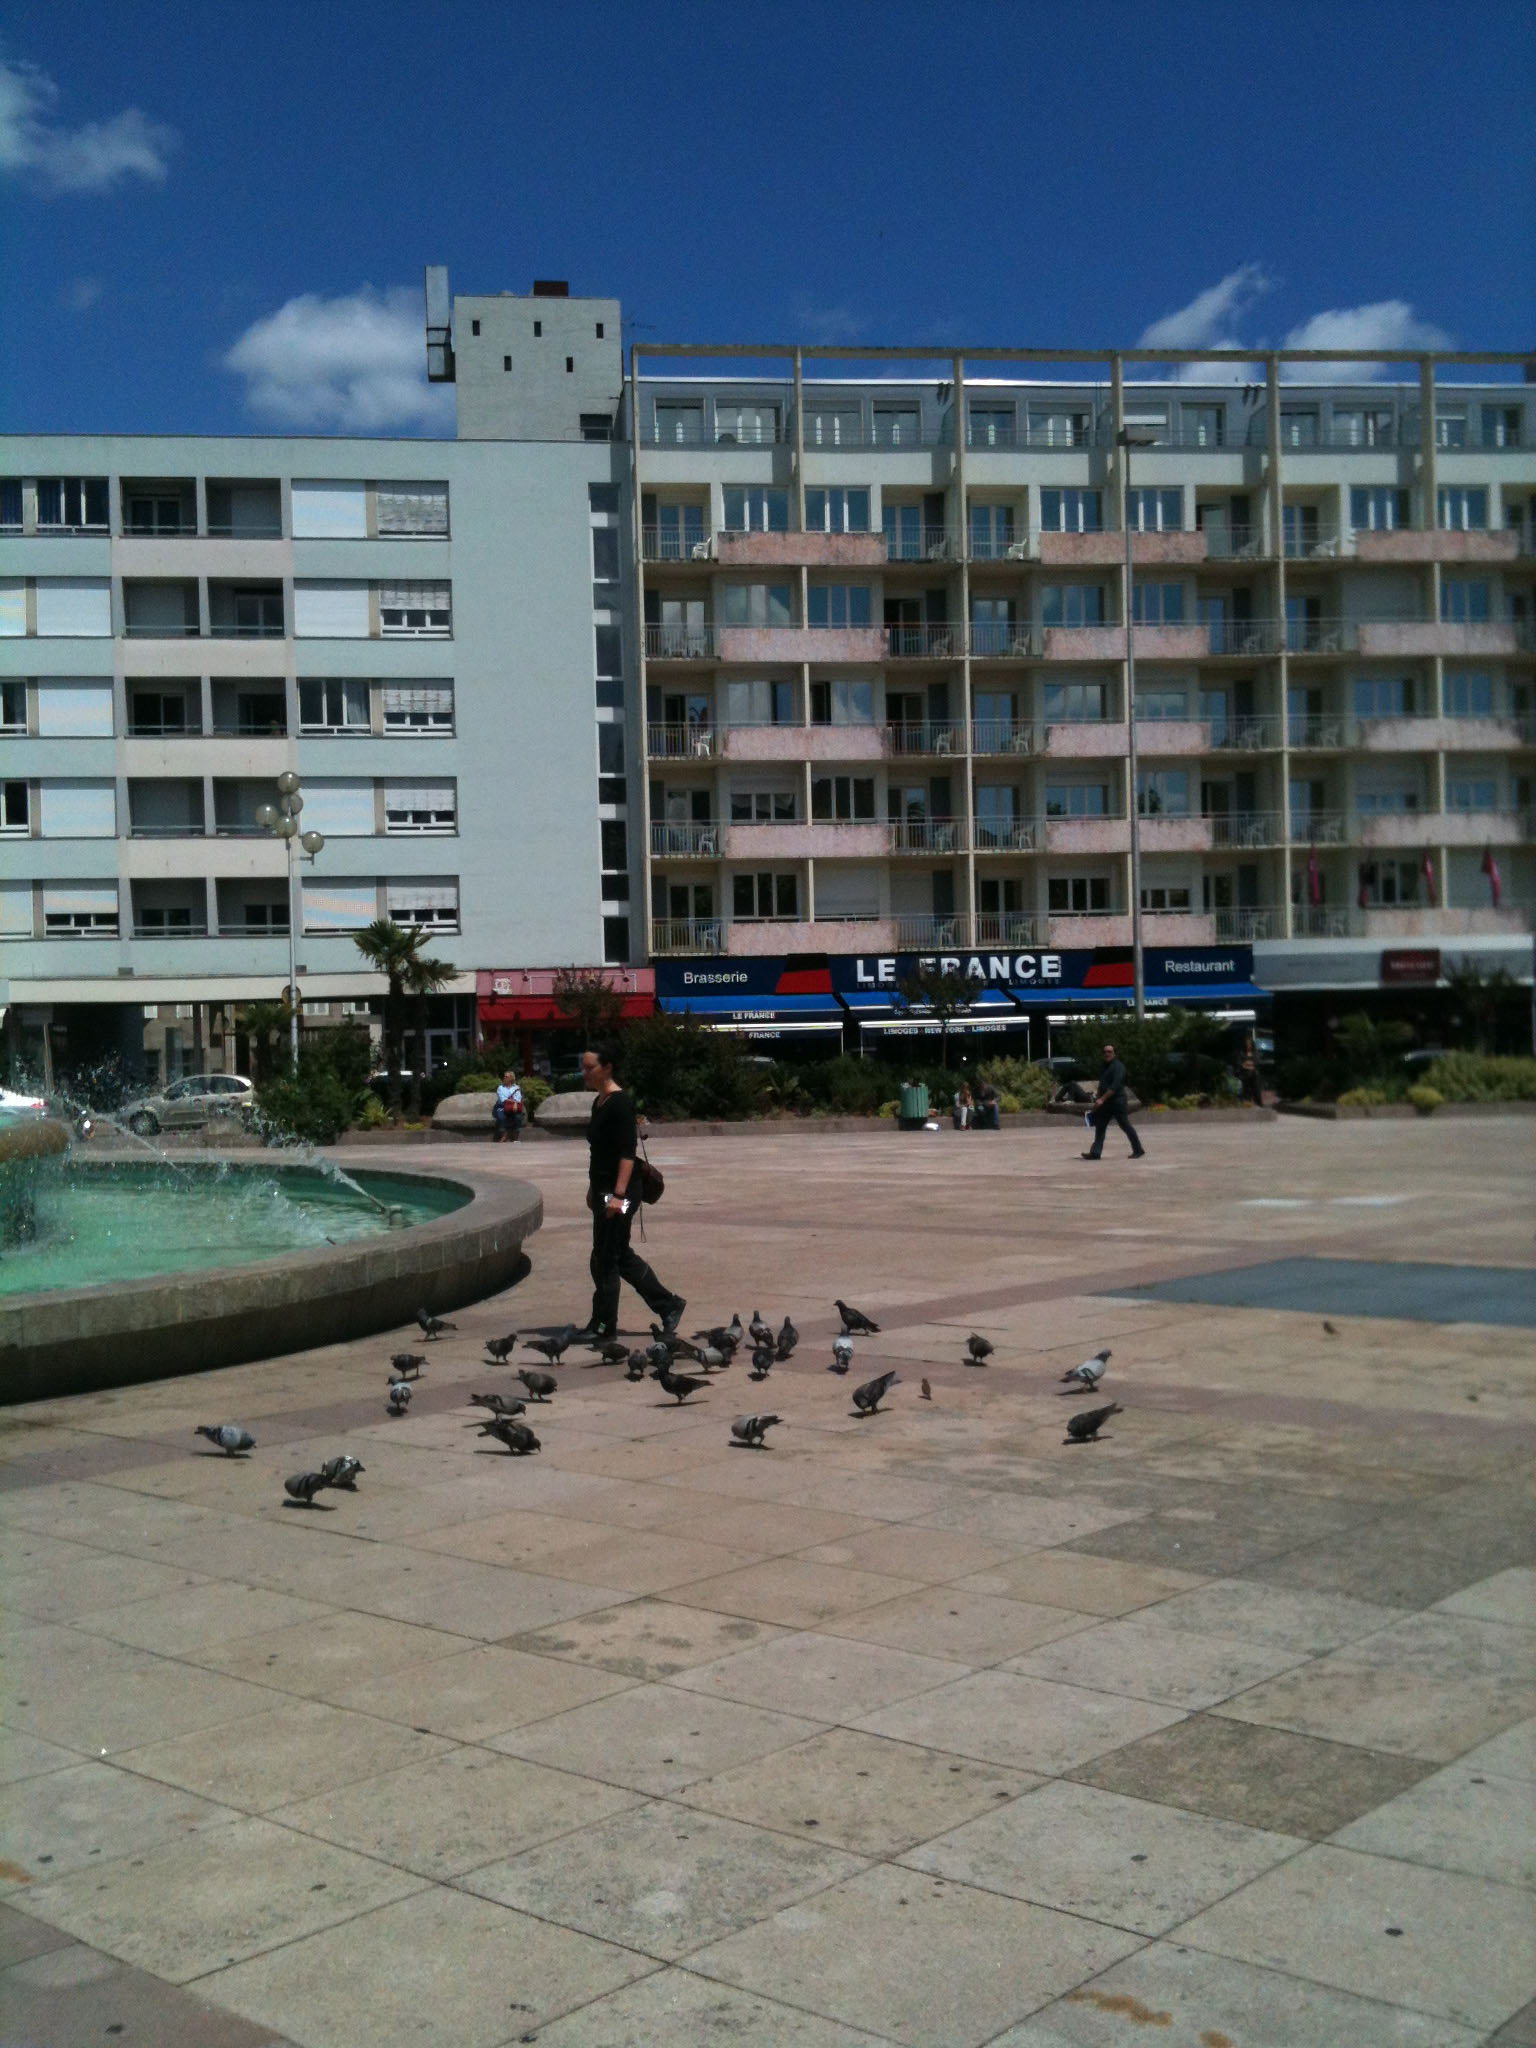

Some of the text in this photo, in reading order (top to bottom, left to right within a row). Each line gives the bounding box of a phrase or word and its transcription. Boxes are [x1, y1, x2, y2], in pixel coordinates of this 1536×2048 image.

[856, 955, 1061, 982] LE FRANCE
[1165, 960, 1236, 973] Restaurant
[683, 971, 748, 984] Brasserie
[732, 1010, 776, 1020] LE FRANCE
[748, 1031, 781, 1039] FRANCE
[884, 1027, 918, 1035] LIMOGES
[972, 1024, 1006, 1033] LIMOGES
